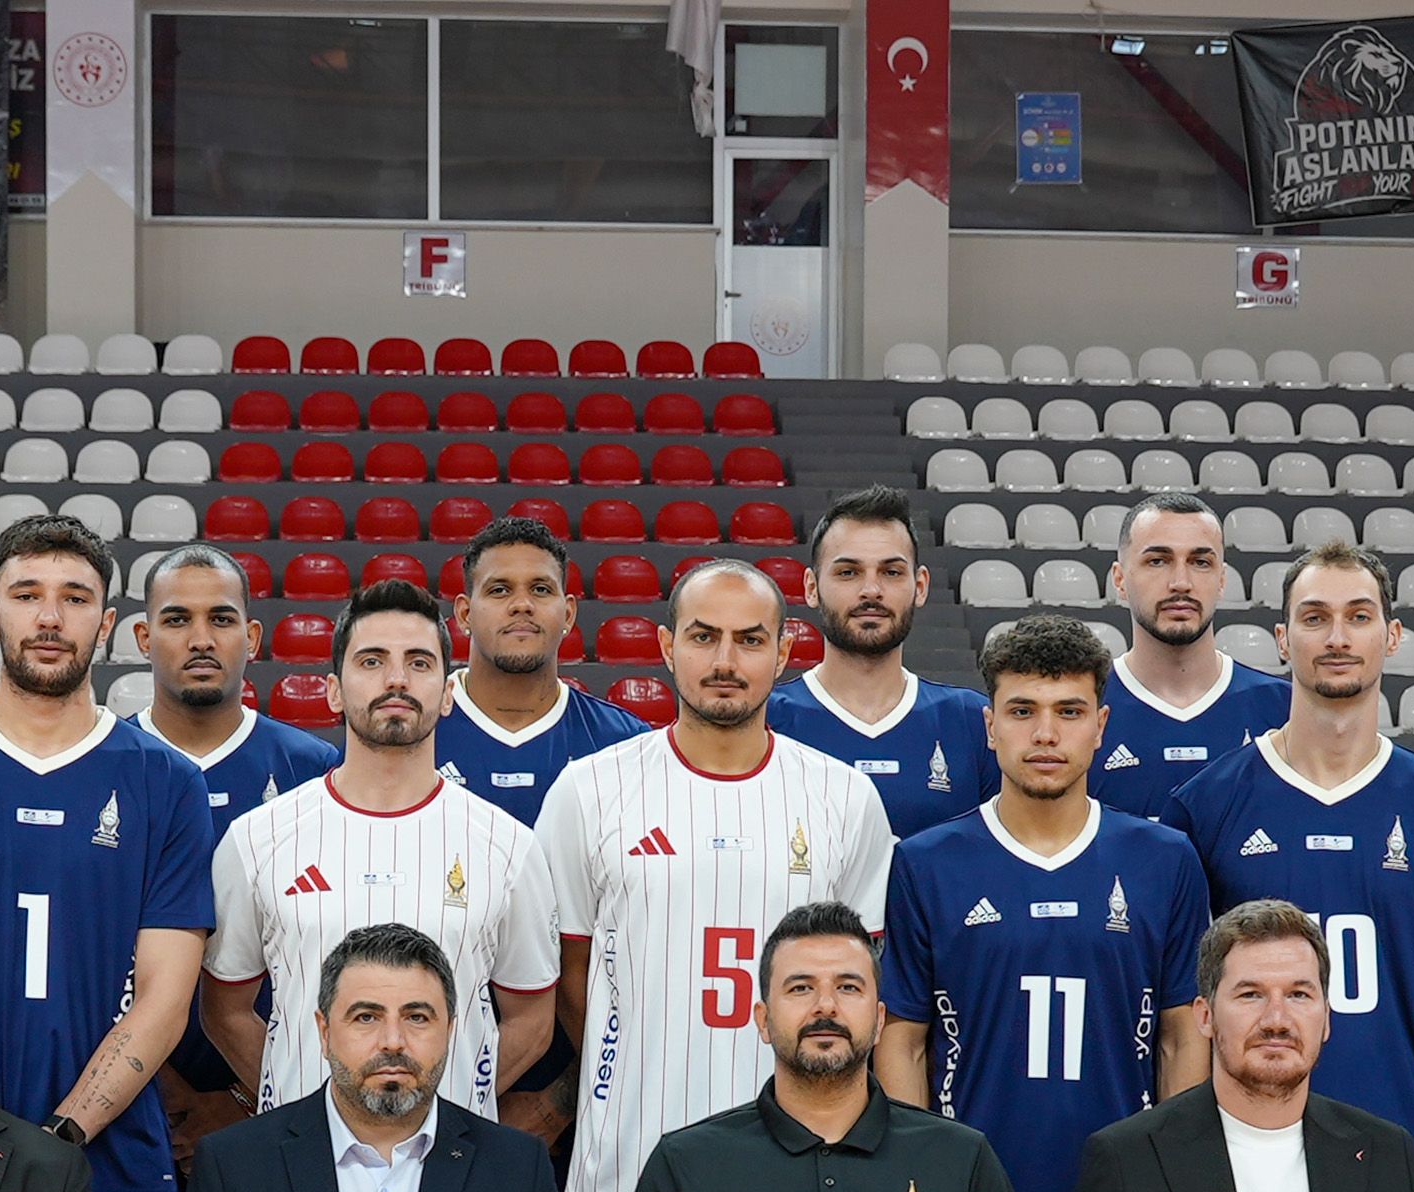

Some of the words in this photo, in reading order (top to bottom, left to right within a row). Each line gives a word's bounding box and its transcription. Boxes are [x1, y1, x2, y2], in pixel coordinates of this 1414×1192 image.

[1278, 179, 1337, 211] FIGHT
[1373, 172, 1411, 195] YOUR
[420, 237, 449, 278] F
[1252, 250, 1288, 291] G
[1104, 757, 1140, 770] adidas
[1240, 843, 1278, 856] adidas
[964, 911, 1002, 926] adidas
[16, 892, 50, 1001] 1
[1306, 911, 1380, 1014] 0
[702, 927, 755, 1029] 5
[1019, 975, 1087, 1081] 11
